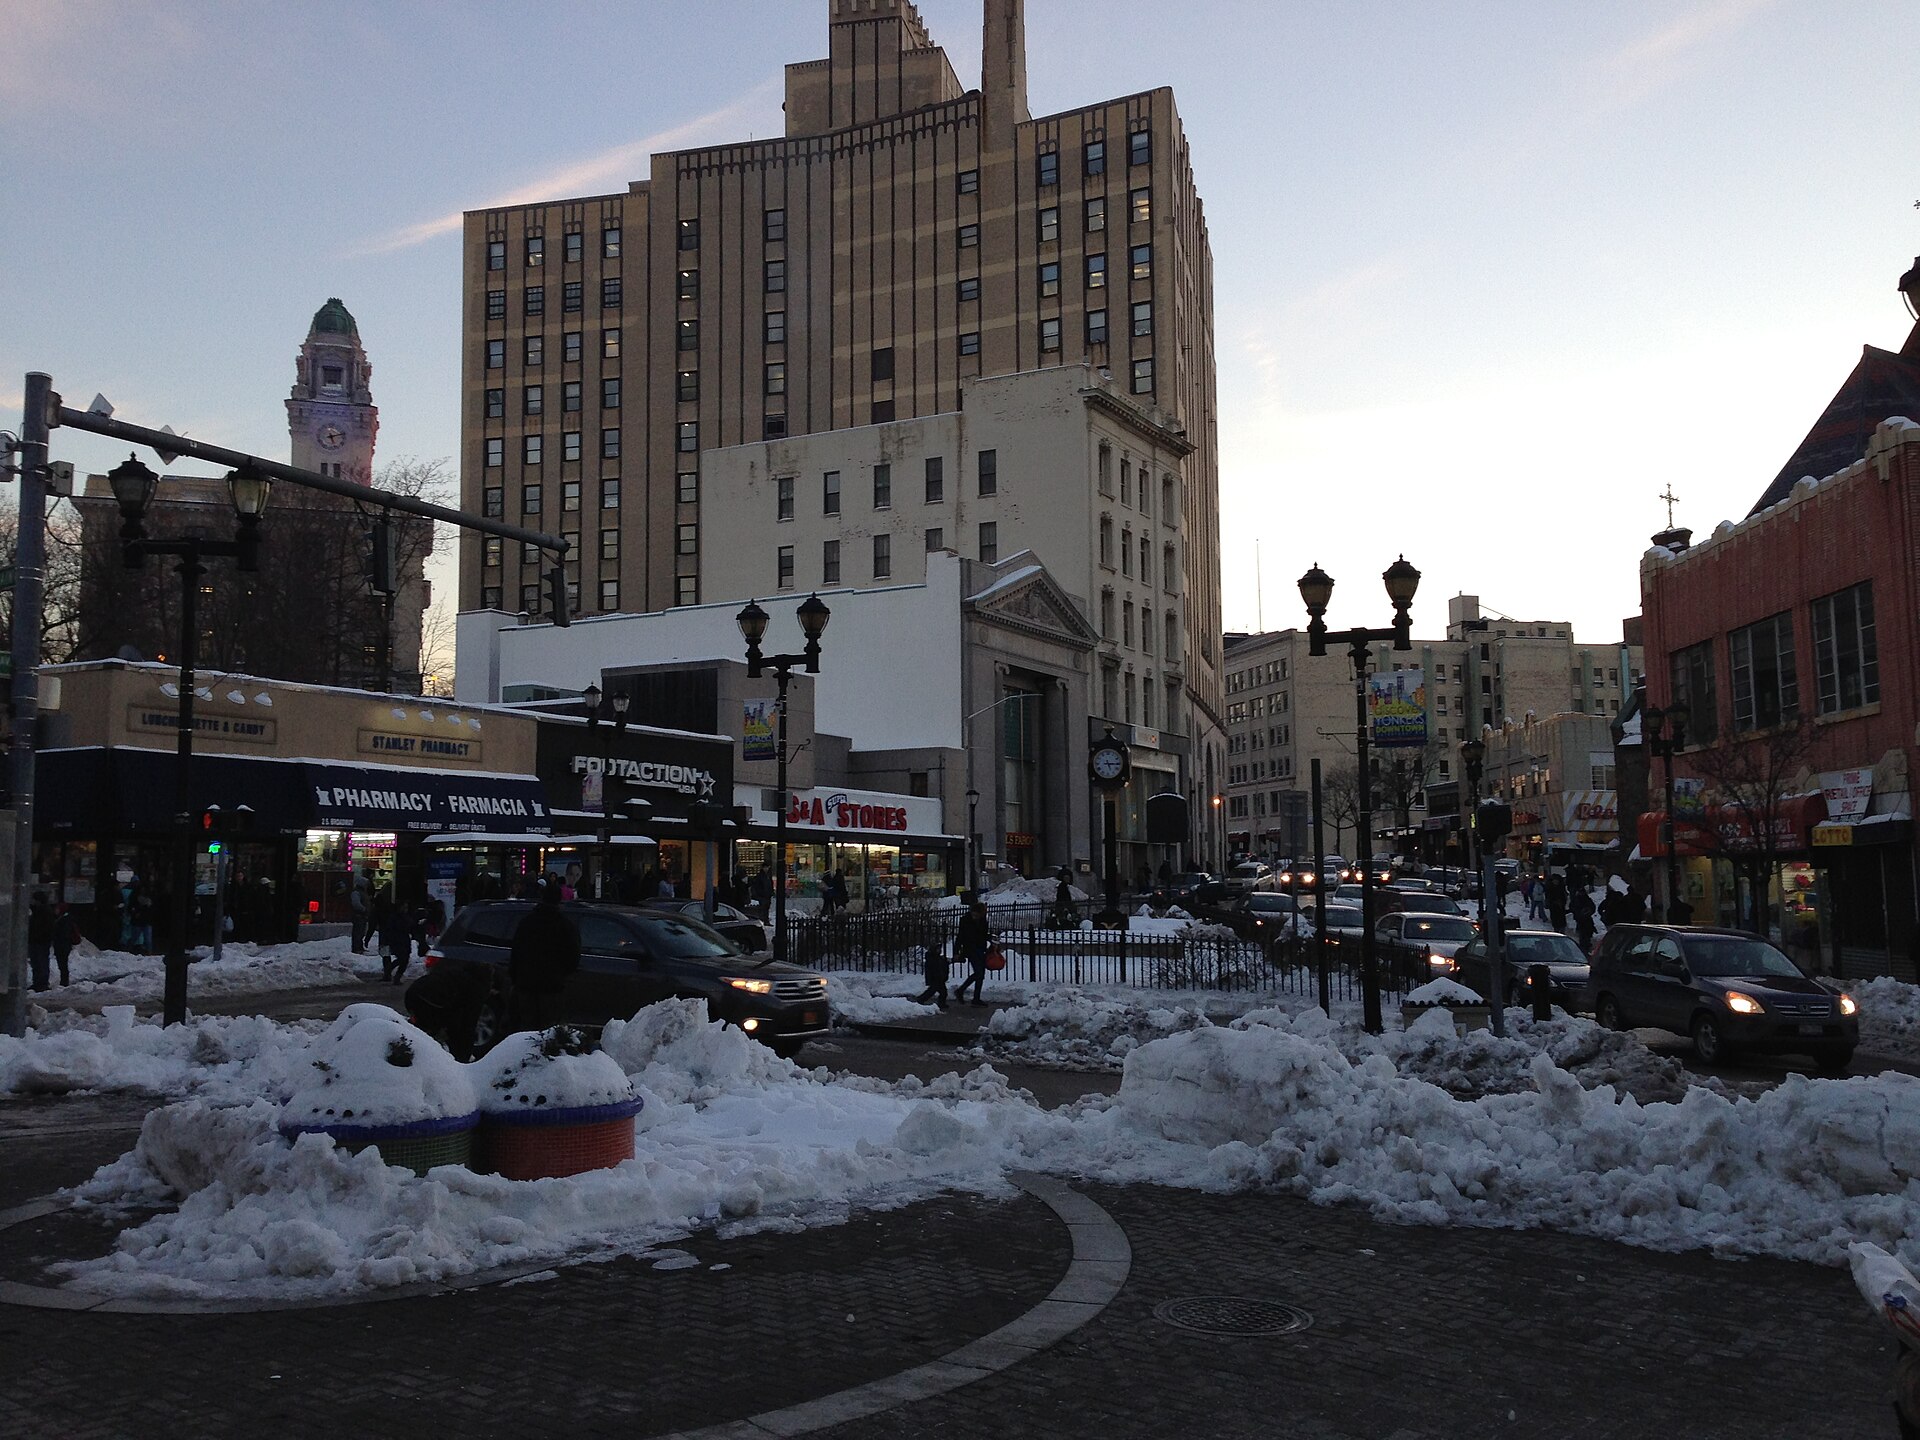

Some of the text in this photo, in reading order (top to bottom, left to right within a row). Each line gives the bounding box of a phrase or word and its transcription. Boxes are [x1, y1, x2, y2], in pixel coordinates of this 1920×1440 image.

[223, 721, 230, 732] &
[233, 722, 265, 735] CANDY
[372, 736, 468, 756] STANLEY PHARMACY
[678, 785, 696, 794] USA
[333, 787, 432, 812] PHARMACY
[447, 794, 527, 816] FARMACIA
[837, 802, 907, 831] STORES
[407, 821, 420, 830] FREE
[420, 822, 442, 831] DELIVERY
[449, 823, 470, 832] DELIVERY
[1813, 828, 1849, 844] LOTTO
